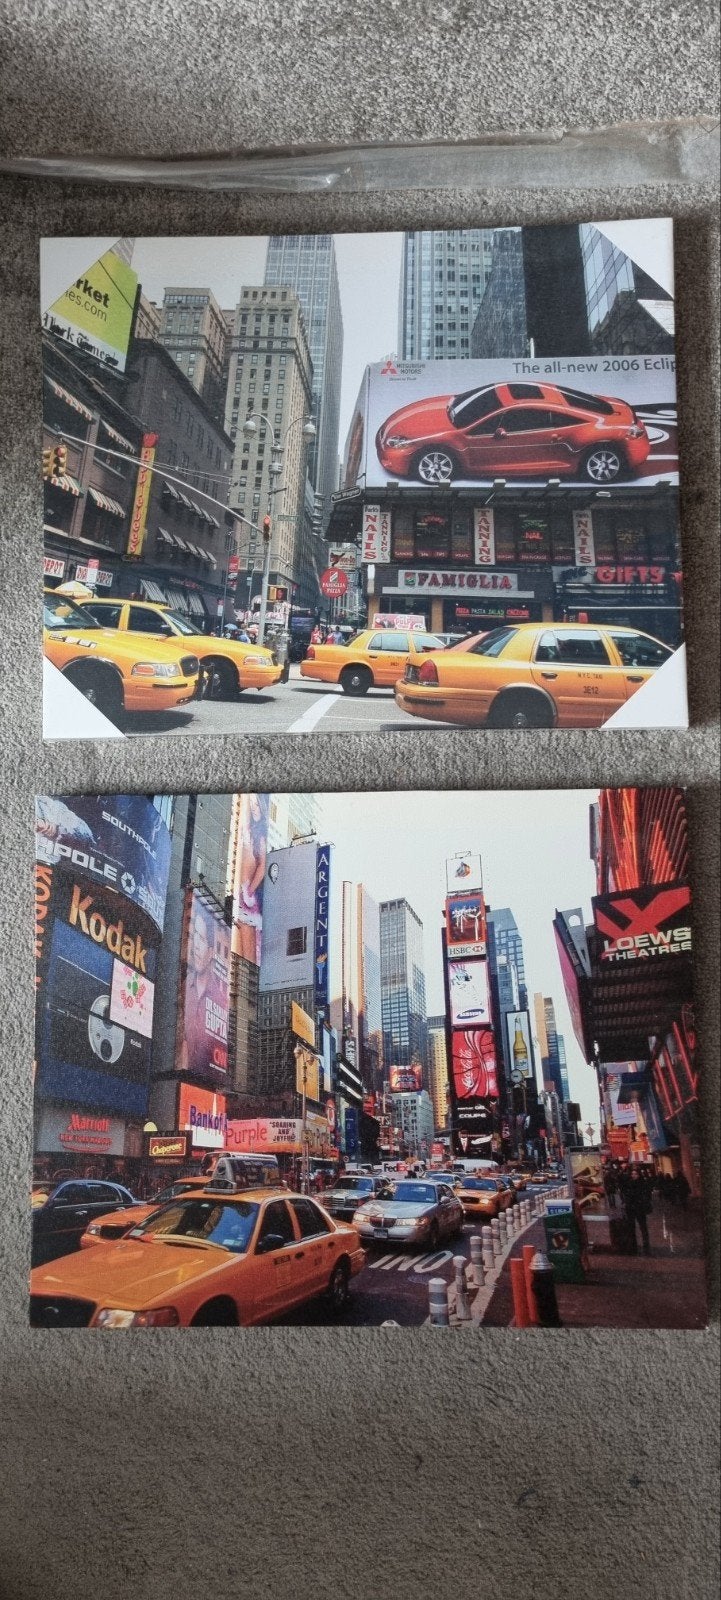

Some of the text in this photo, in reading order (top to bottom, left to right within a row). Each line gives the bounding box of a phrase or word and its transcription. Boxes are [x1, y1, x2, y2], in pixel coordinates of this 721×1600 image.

[73, 277, 110, 309] rket
[512, 362, 540, 374] The
[544, 361, 598, 373] all-new
[602, 359, 640, 372] 2006
[363, 514, 378, 560] NAILS
[381, 513, 390, 553] TANNING
[477, 509, 492, 563] TANNING
[577, 520, 592, 564] NAILS
[417, 572, 513, 590] FAMIGLIA
[596, 565, 664, 584] GIFTS
[101, 810, 158, 860] SOUTHPOLE
[316, 852, 330, 948] ARGENT
[69, 885, 148, 974] Kodak
[603, 926, 692, 953] LOEWS
[449, 946, 472, 955] HSBC
[605, 940, 692, 962] THEATRES
[205, 1010, 228, 1041] GUPTA
[190, 1104, 213, 1130] Bank
[224, 1121, 268, 1147] Purple
[383, 1162, 409, 1173] FedEx
